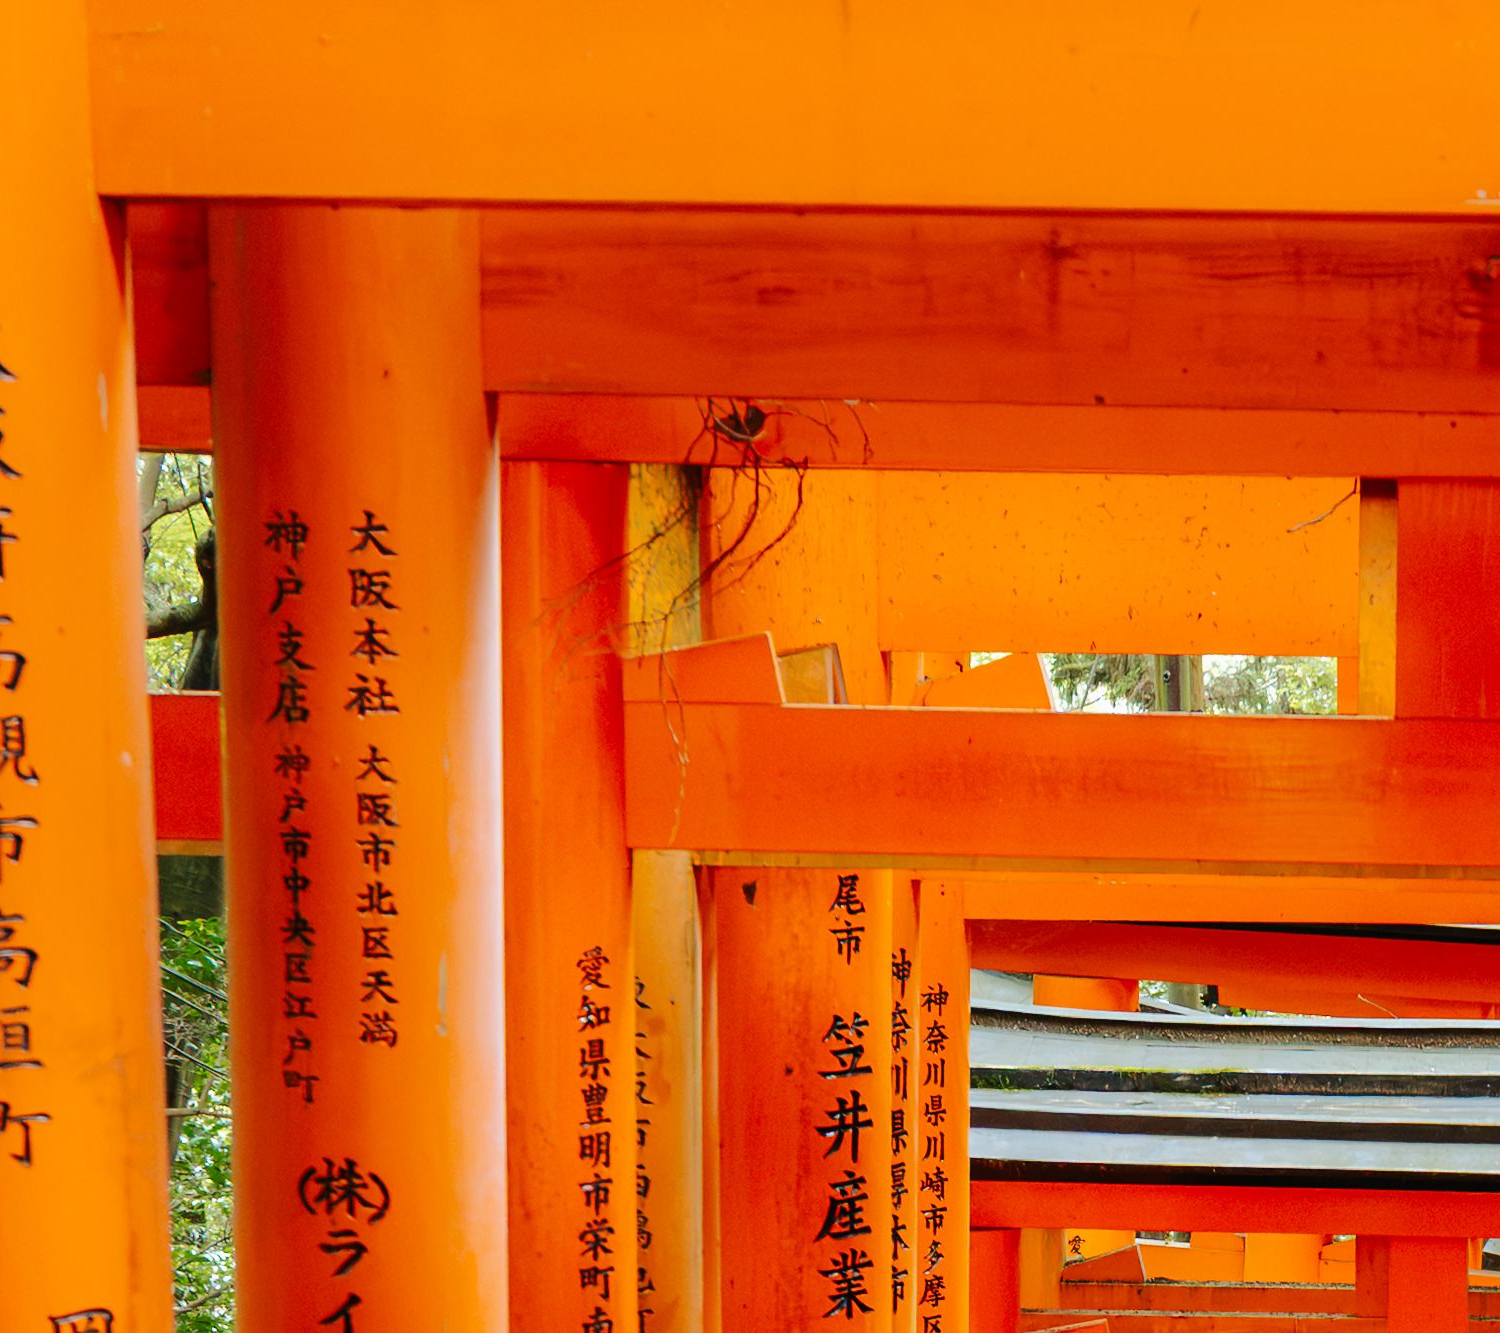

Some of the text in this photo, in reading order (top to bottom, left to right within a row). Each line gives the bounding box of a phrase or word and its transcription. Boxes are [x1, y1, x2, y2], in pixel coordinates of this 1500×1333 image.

[264, 511, 313, 725] 神戸支店
[345, 510, 400, 1047] 大阪本社 大阪市北区天満
